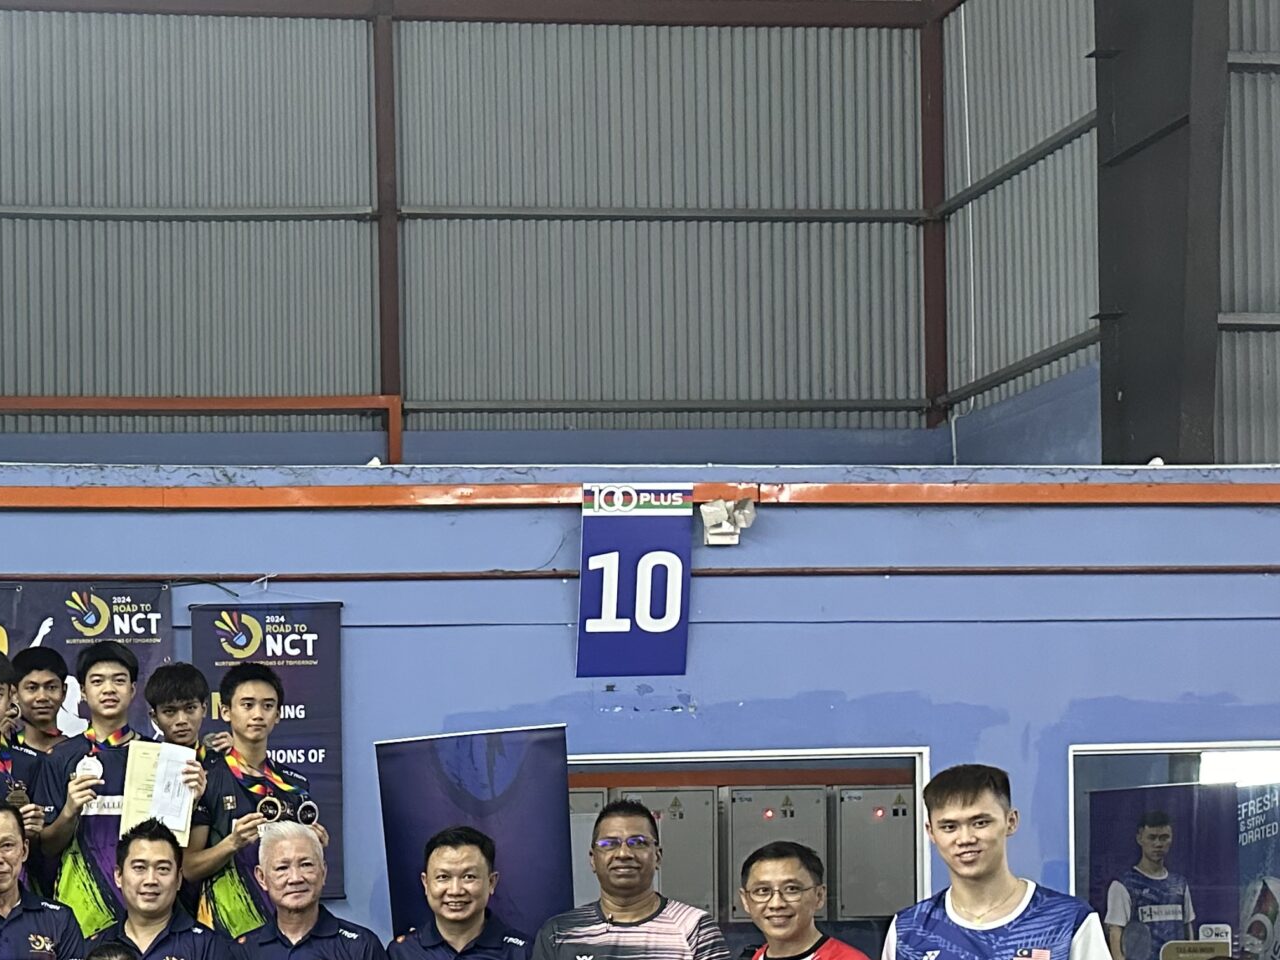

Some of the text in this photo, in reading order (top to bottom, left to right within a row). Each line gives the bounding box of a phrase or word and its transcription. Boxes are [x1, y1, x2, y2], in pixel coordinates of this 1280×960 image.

[591, 485, 683, 512] 100 PLUS
[586, 551, 683, 633] 10
[112, 596, 130, 604] 2024
[112, 605, 151, 613] ROAD TO
[114, 613, 161, 635] NCT
[266, 615, 284, 623] 2024
[266, 624, 307, 632] ROAD TO
[266, 634, 318, 656] NCT
[309, 750, 325, 762] OF
[1240, 813, 1266, 832] & STAY
